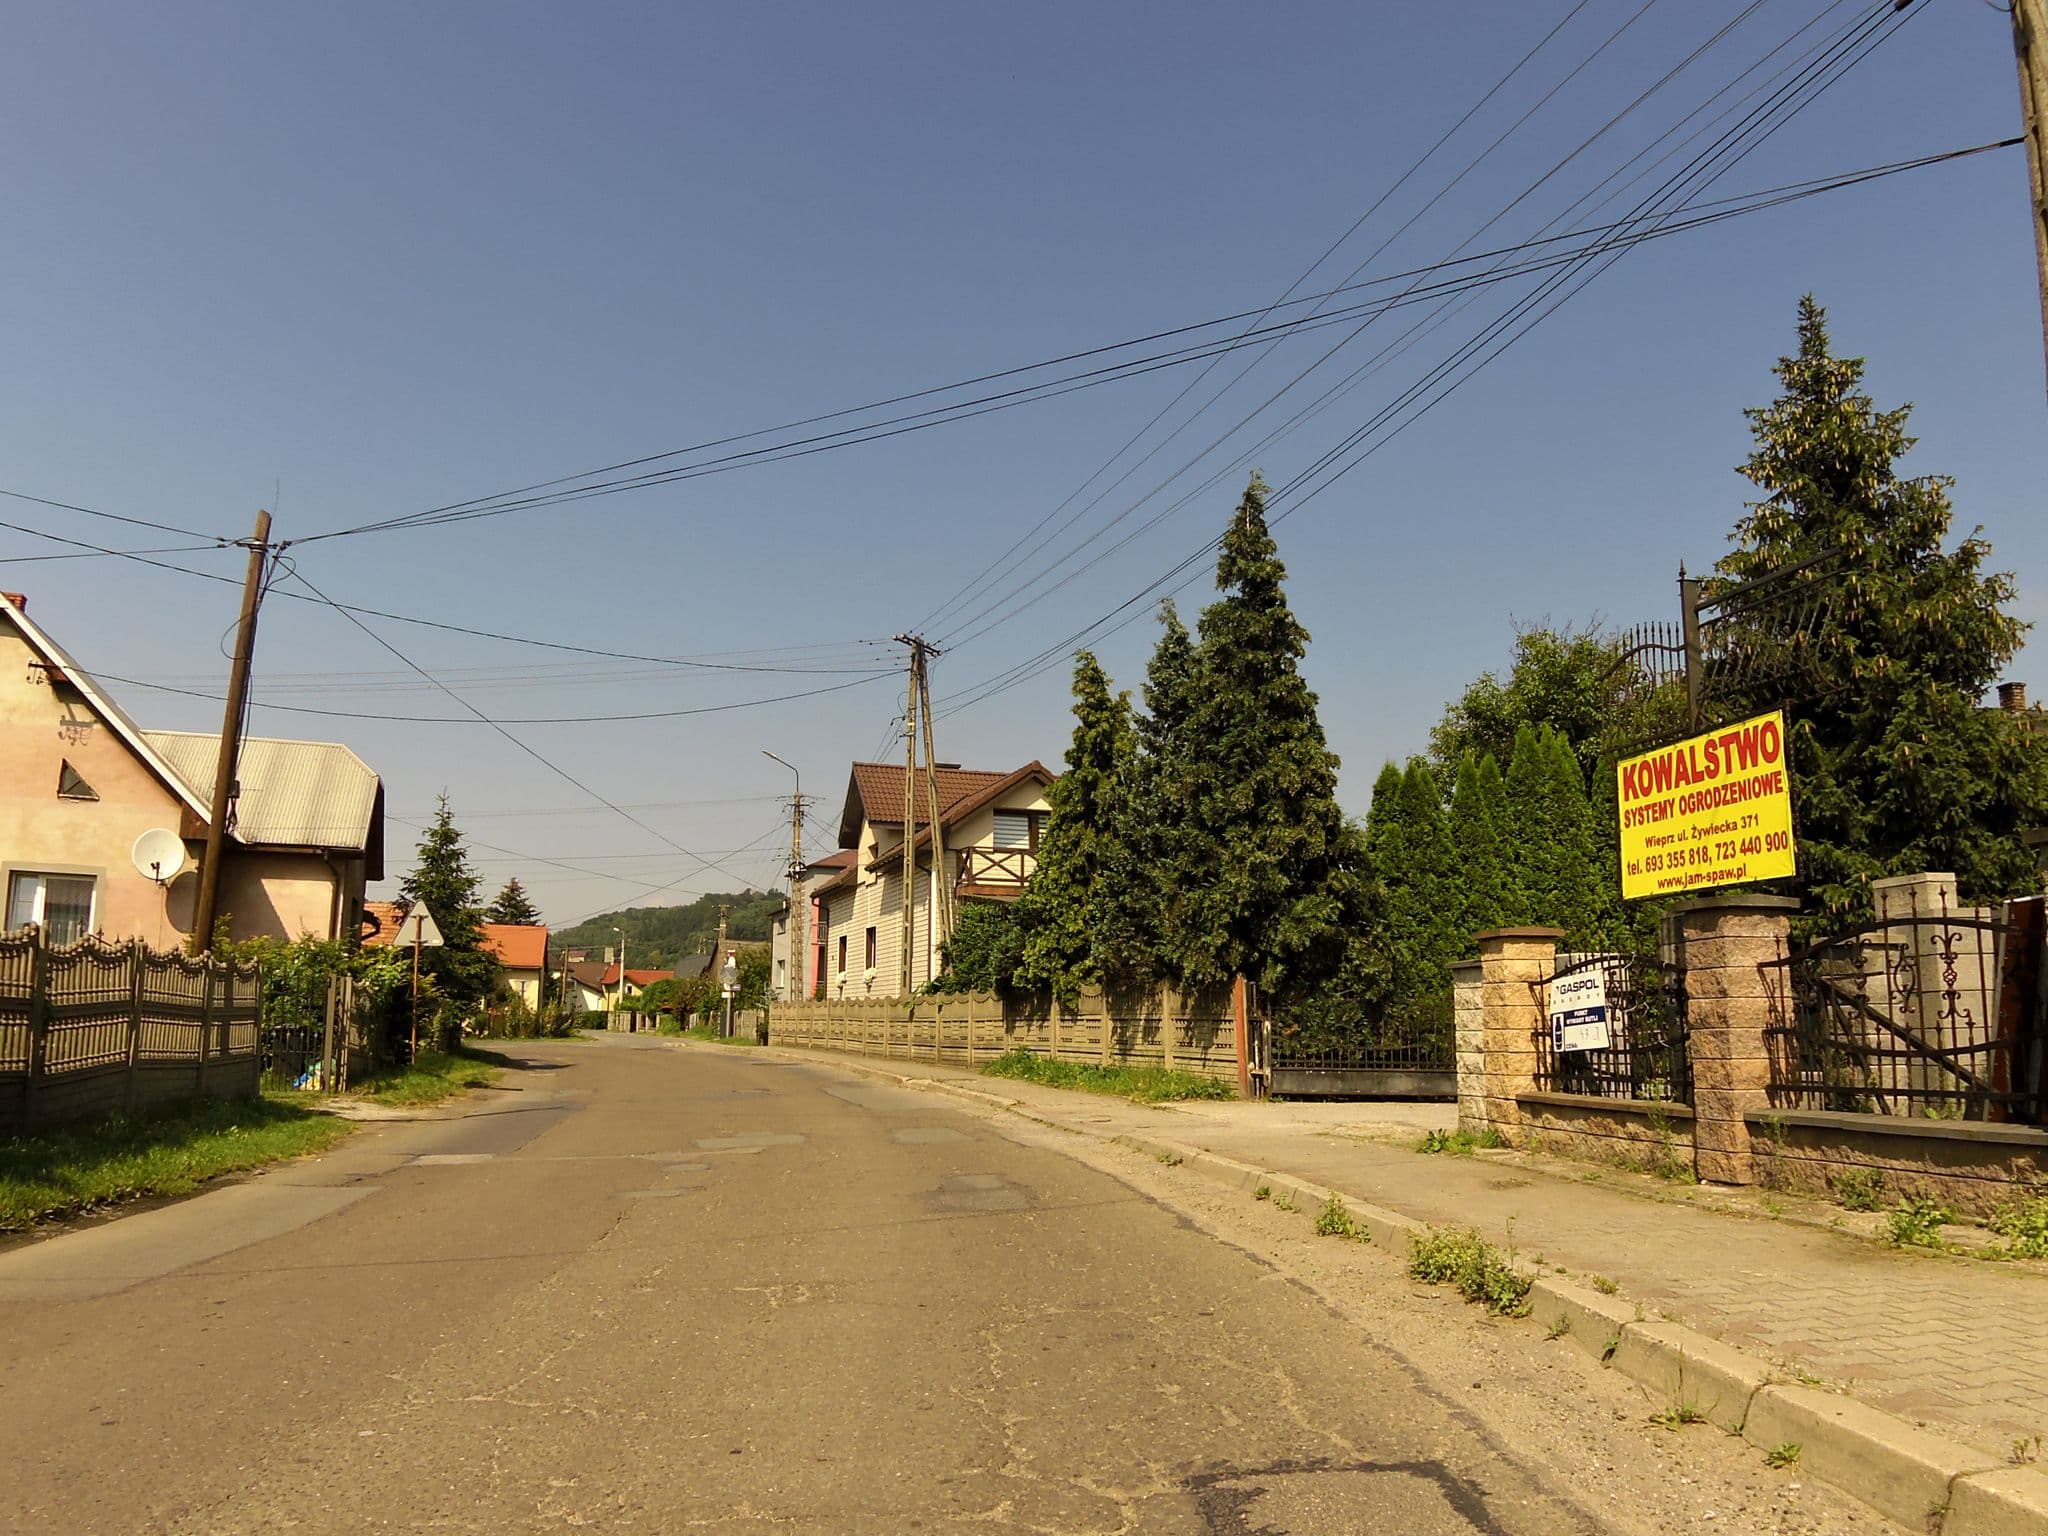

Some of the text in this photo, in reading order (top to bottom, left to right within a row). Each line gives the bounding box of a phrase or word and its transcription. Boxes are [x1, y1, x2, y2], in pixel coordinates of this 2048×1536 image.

[1623, 721, 1780, 801] KOWALSTWO
[1624, 771, 1783, 829] SYSTEMY OGRODZENIOWE
[1645, 814, 1759, 848] Wieprz ul. Żywiecka 371
[1627, 831, 1788, 876] tel. 693 355 818, 723 440 900
[1658, 863, 1746, 889] www.jam-spaw.pl
[1560, 979, 1599, 995] GASPOL
